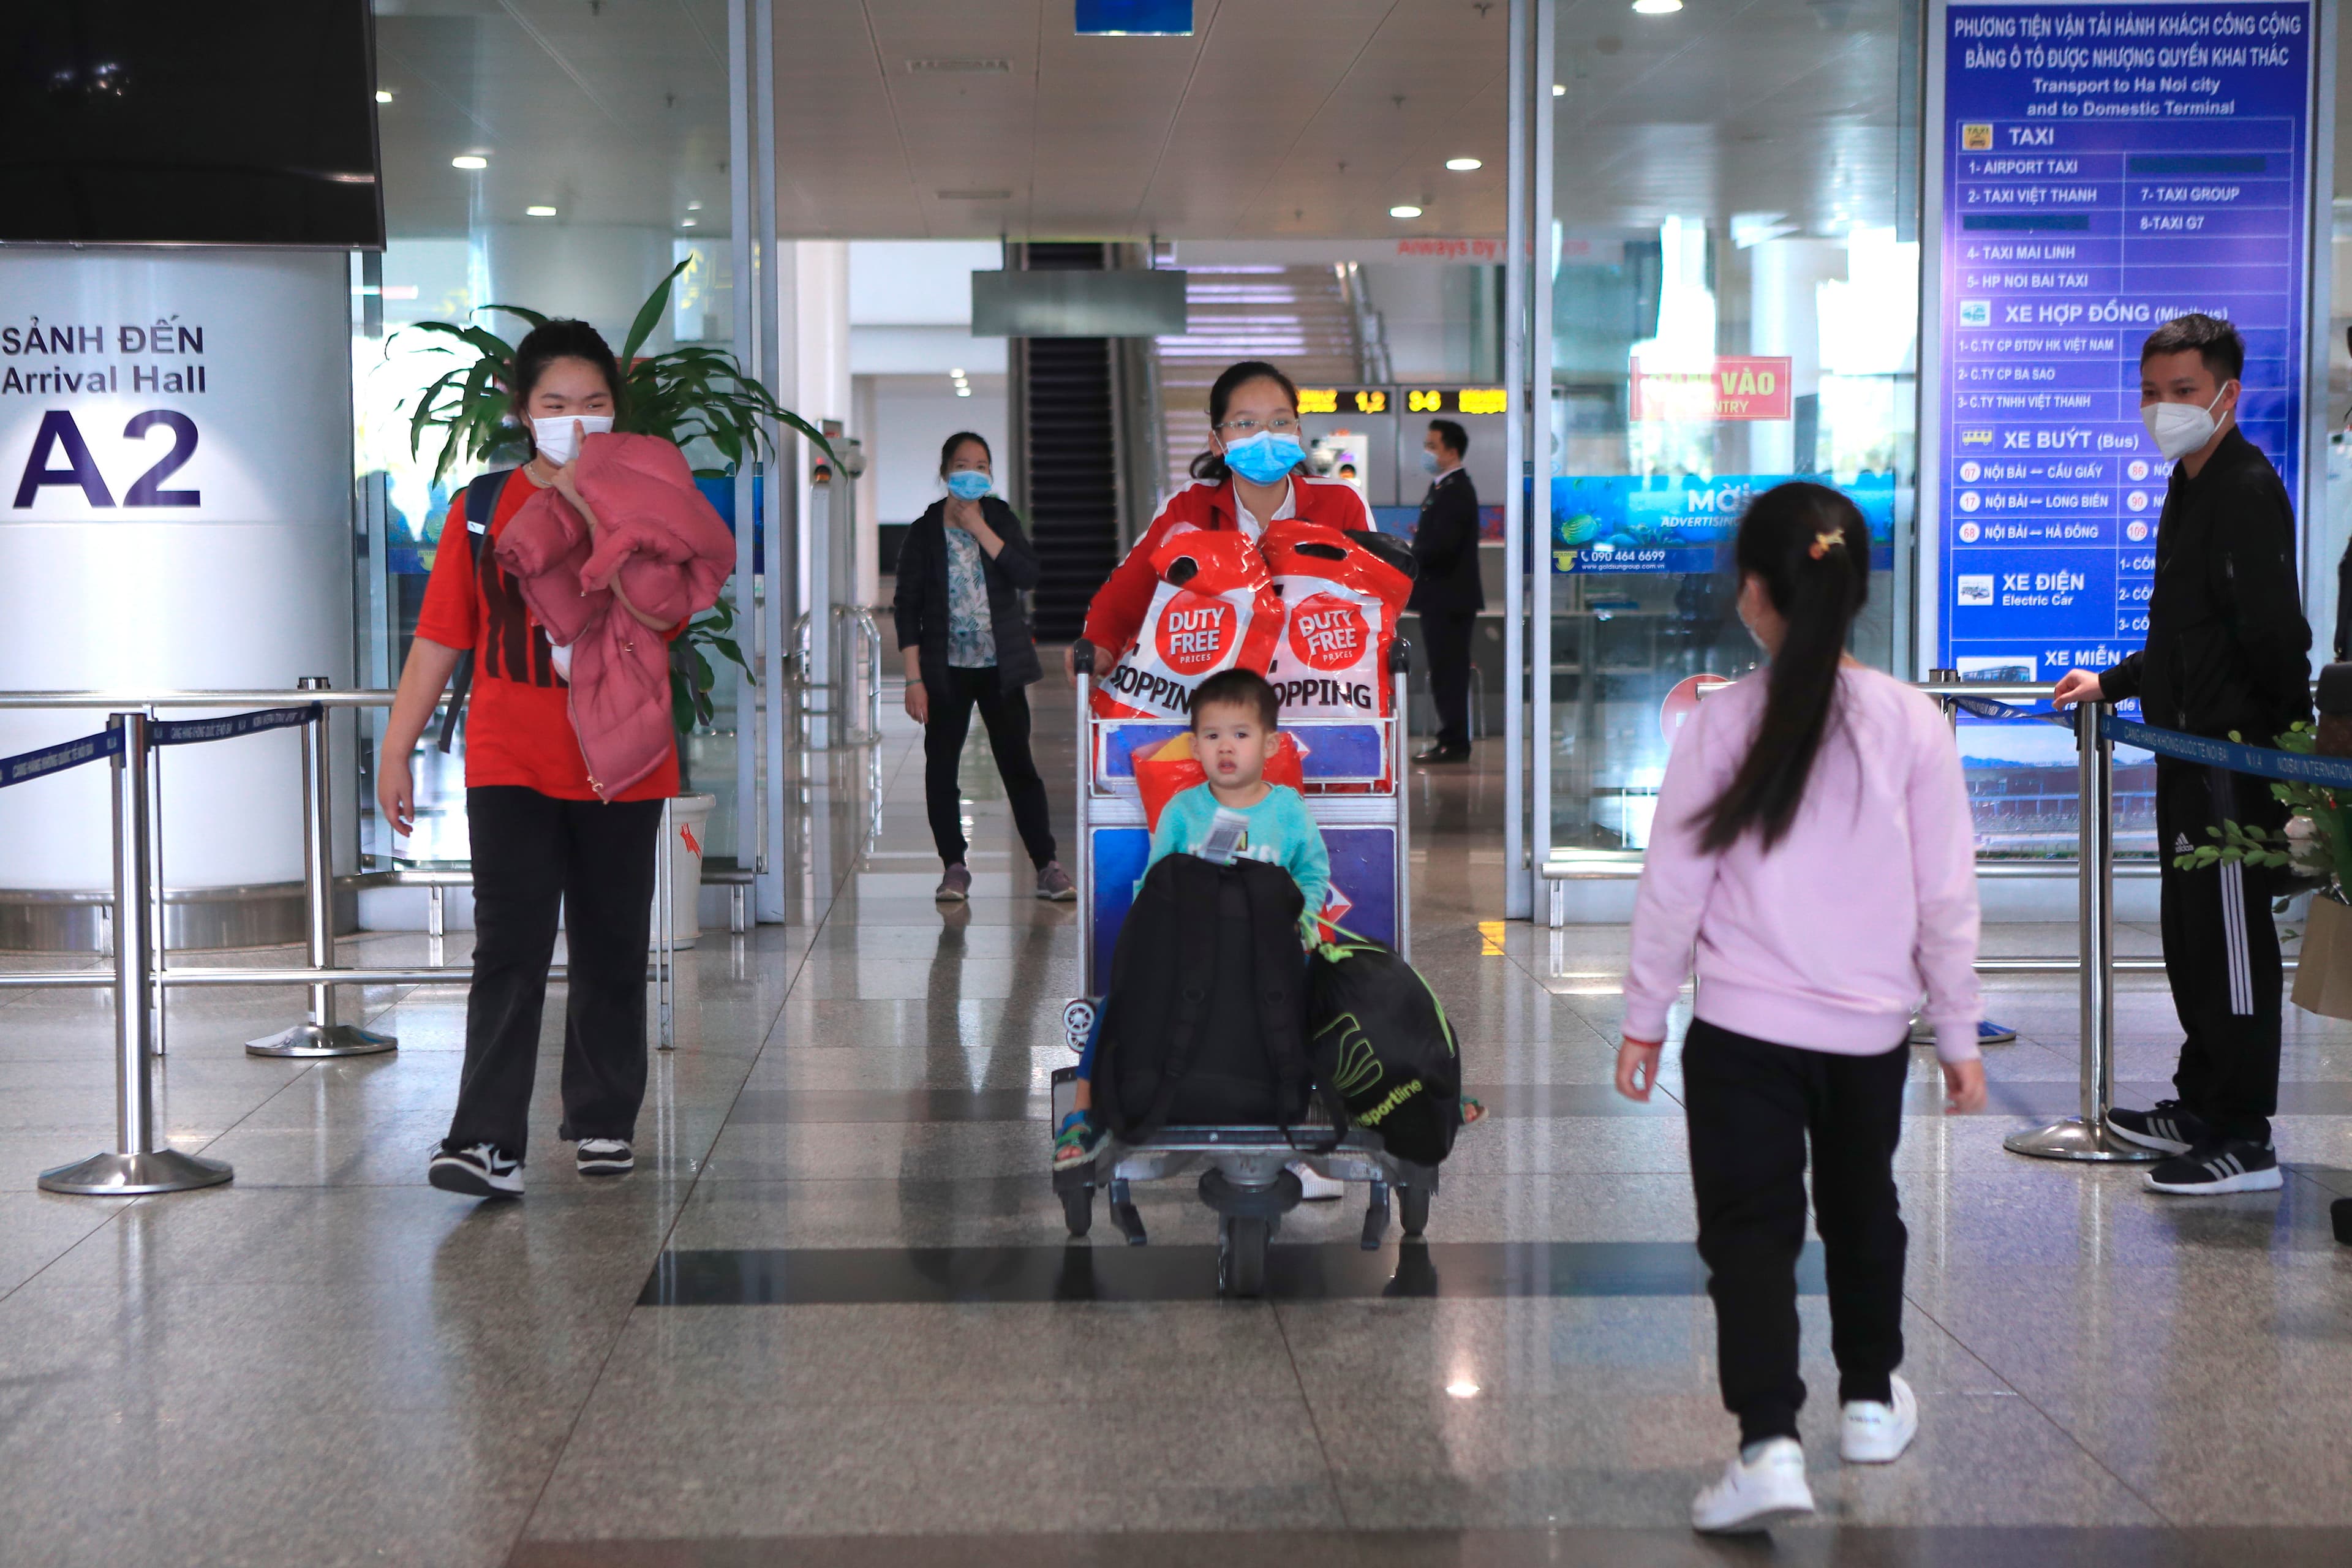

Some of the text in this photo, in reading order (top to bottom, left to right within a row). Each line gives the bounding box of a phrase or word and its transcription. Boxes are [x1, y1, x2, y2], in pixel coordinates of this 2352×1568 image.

[1954, 10, 2301, 42] PHƯƠNG TIỆN VẬN TẢI HÀNH KHÁCH CÔNG CỘNG
[1965, 40, 2006, 69] BẰNG
[2010, 43, 2021, 68] Ô
[2024, 43, 2044, 68] TÔ
[2048, 45, 2089, 73] ĐƯỢC
[2092, 45, 2155, 72] NHƯỢNG
[2212, 47, 2246, 67] KHAI
[2250, 43, 2289, 66] THÁC
[2033, 77, 2221, 97] Transport to Ha Noi city
[2027, 99, 2235, 116] and to Domestic Terminal
[2009, 127, 2054, 145] TAXI
[1983, 159, 2043, 174] AIRPORT
[2047, 159, 2078, 174] TAXI
[1983, 187, 2013, 202] TAXI
[2017, 185, 2047, 205] VIỆT
[2050, 187, 2097, 202] THANH
[2157, 187, 2187, 202] TAXI
[2190, 186, 2240, 202] GROUP
[2186, 216, 2204, 230] G7
[1983, 246, 2013, 259] TAXI
[2016, 245, 2040, 259] MAI
[2045, 245, 2075, 259] LINH
[1983, 274, 2000, 287] HP
[2005, 274, 2027, 287] NOI
[2032, 274, 2054, 287] BAI
[2057, 274, 2088, 287] TAXI
[2005, 305, 2032, 322] XE
[2039, 303, 2082, 326] HỢP
[2088, 297, 2150, 322] ĐỒNG
[2, 314, 203, 355] SẢNH ĐẾN
[1970, 340, 1994, 352] C.TY
[1997, 339, 2012, 352] CP
[2015, 339, 2043, 352] ĐTDV
[2046, 339, 2061, 352] HK
[2064, 336, 2087, 354] VIỆT
[2089, 339, 2114, 352] NAM
[1, 364, 206, 394] Arrival Hall
[1721, 368, 1775, 396] VÀO
[1970, 368, 1994, 380] C.TY
[1997, 368, 2012, 380] CP
[2014, 368, 2029, 380] BA
[2032, 368, 2055, 380] SAO
[1969, 397, 1993, 409] C.TY
[1996, 396, 2026, 408] TNHH
[2028, 393, 2051, 410] VIỆT
[2054, 396, 2091, 408] THANH
[2004, 428, 2139, 451] XE BUÝT (Bus)
[12, 410, 201, 509] A2
[1964, 469, 1975, 479] 07
[1984, 462, 2003, 481] NỘI
[2007, 462, 2026, 478] BÀI
[2075, 460, 2103, 478] GIẤY
[2132, 466, 2144, 477] 86
[1965, 491, 2108, 511] 17 NỘI BÀI LONG BIÊN
[2132, 497, 2144, 507] 90
[1964, 522, 2098, 542] 68 NỘI BÀI HÀ ĐÔNG
[2129, 526, 2146, 537] 109
[1592, 551, 1665, 562] 090 464 6699
[2002, 570, 2084, 595] XE ĐIỆN
[2002, 594, 2073, 606] Electric Car
[1169, 607, 1225, 633] DUTY
[1298, 609, 1355, 638] DUTY
[1170, 630, 1220, 655] FREE
[1307, 628, 1357, 655] FREE
[1180, 654, 1211, 663] PRICES
[1323, 650, 1353, 662] PRICES
[2045, 644, 2121, 666] XE MIỄN
